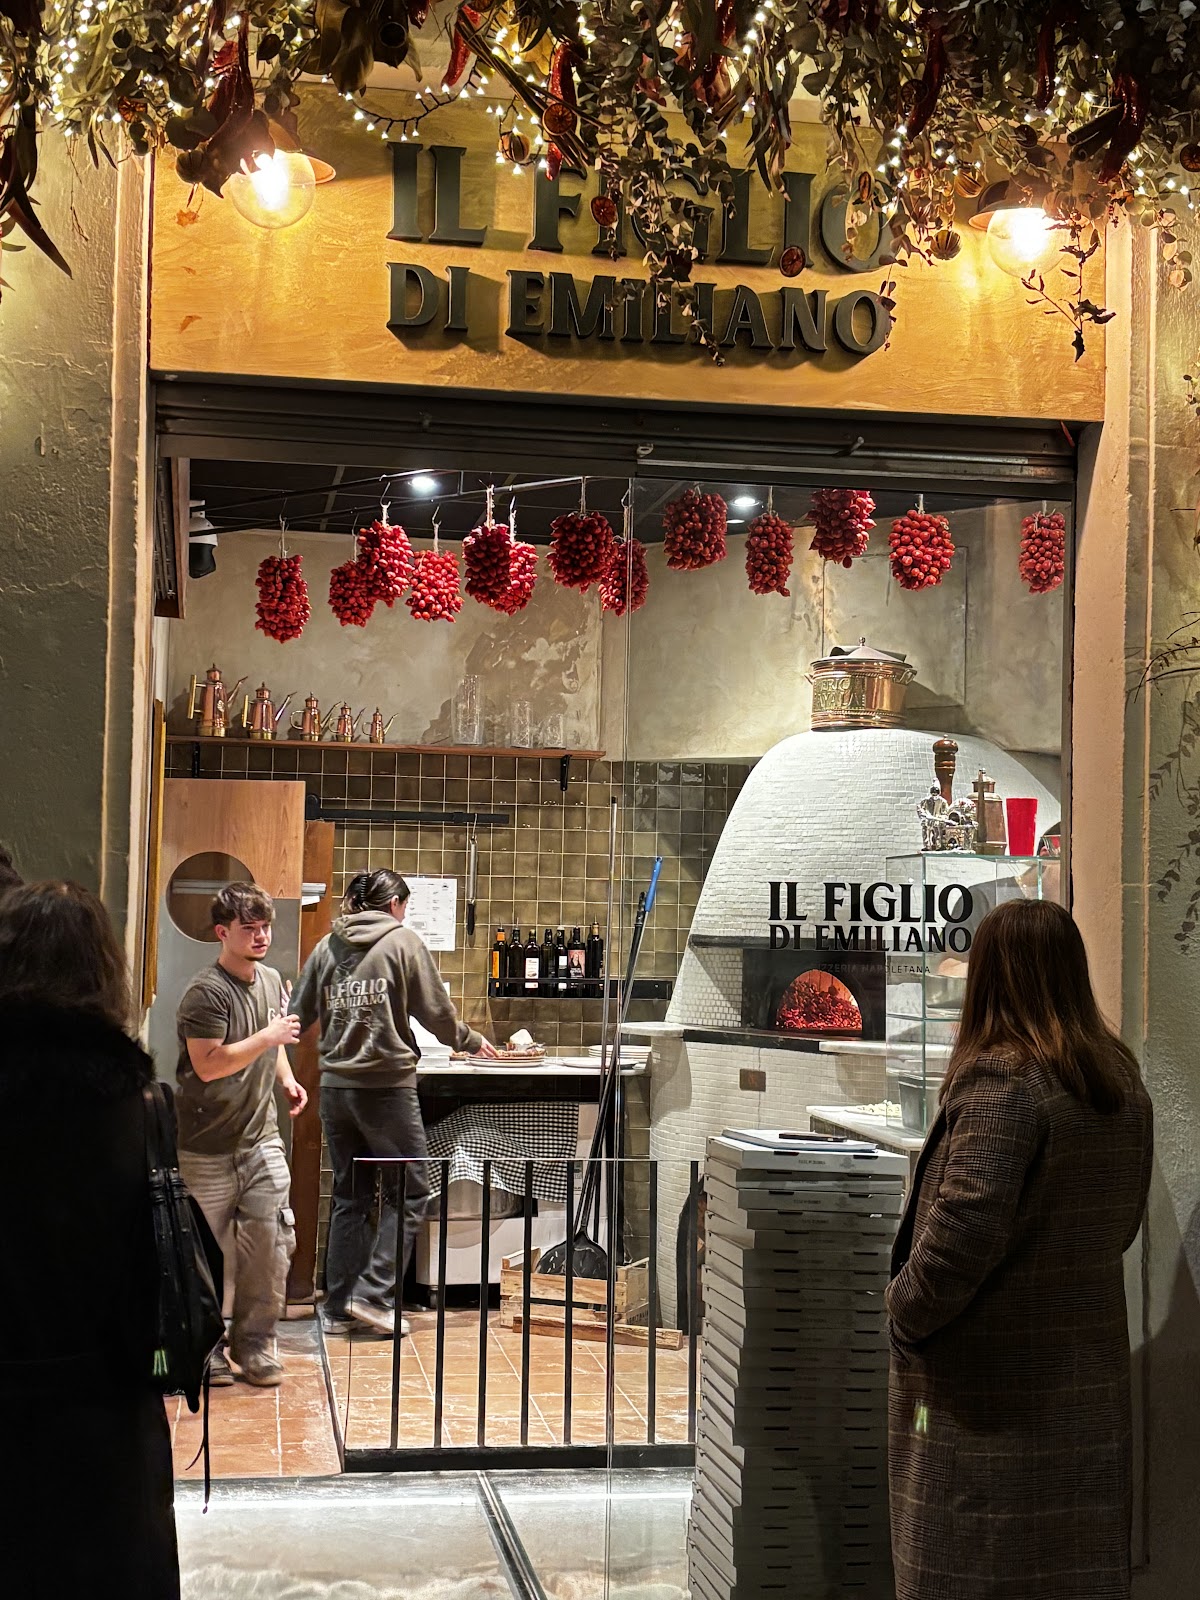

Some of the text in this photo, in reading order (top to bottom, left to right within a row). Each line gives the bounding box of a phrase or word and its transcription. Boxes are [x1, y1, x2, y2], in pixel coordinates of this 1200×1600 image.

[386, 141, 488, 247] IL
[386, 262, 891, 355] DI EMILIANO
[768, 881, 973, 923] IL FIGLIO
[769, 924, 972, 953] DI EMILIANO
[323, 977, 388, 1000] IL FIGLIO
